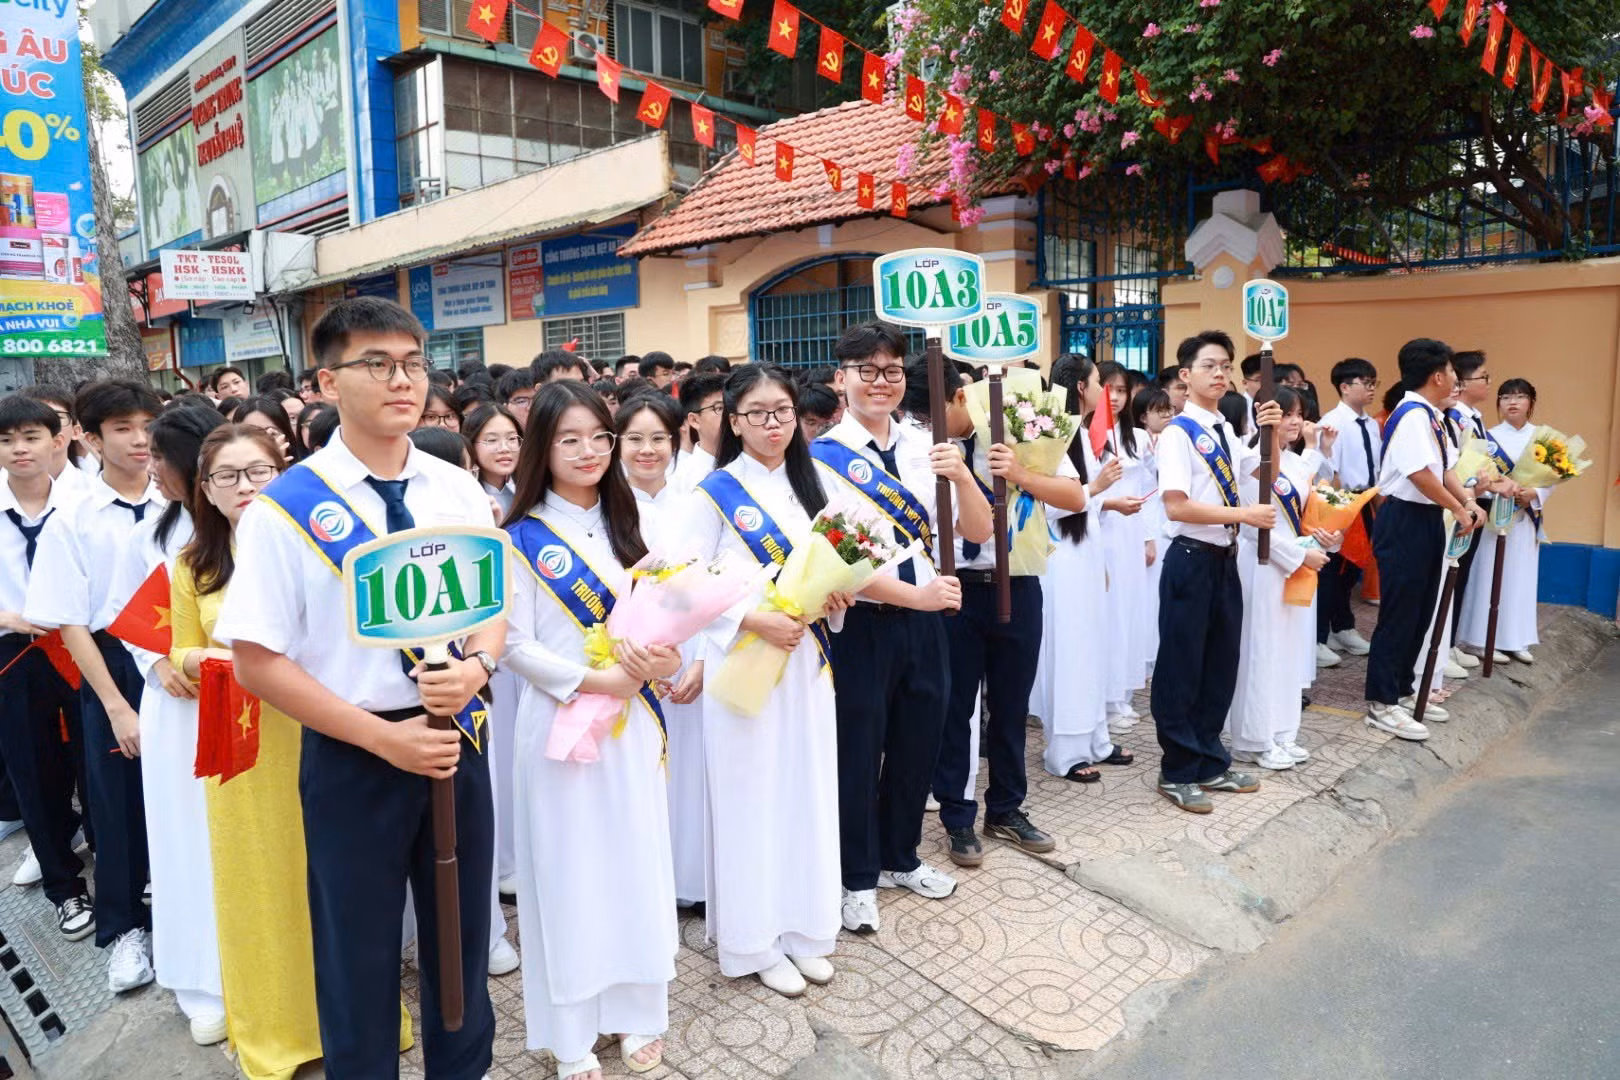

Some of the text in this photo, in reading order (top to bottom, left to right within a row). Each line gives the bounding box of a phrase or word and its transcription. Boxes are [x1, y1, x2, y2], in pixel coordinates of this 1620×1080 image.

[16, 28, 67, 63] ÂU
[0, 110, 80, 160] 0%
[174, 265, 200, 274] HSK
[211, 265, 245, 275] HSKK
[177, 254, 198, 264] TKT
[208, 256, 239, 264] TESOL
[915, 258, 940, 268] LỚP
[884, 268, 978, 309] 10A3
[986, 301, 1002, 310] ỚP
[1248, 296, 1285, 327] 10A7
[36, 318, 60, 329] VUI
[953, 311, 1036, 348] 10A5
[47, 338, 97, 353] 6821
[876, 482, 921, 525] TRƯỜNG THPT
[410, 542, 446, 559] LỚP
[360, 551, 501, 629] 10A1
[571, 577, 606, 621] TRƯỜNG
